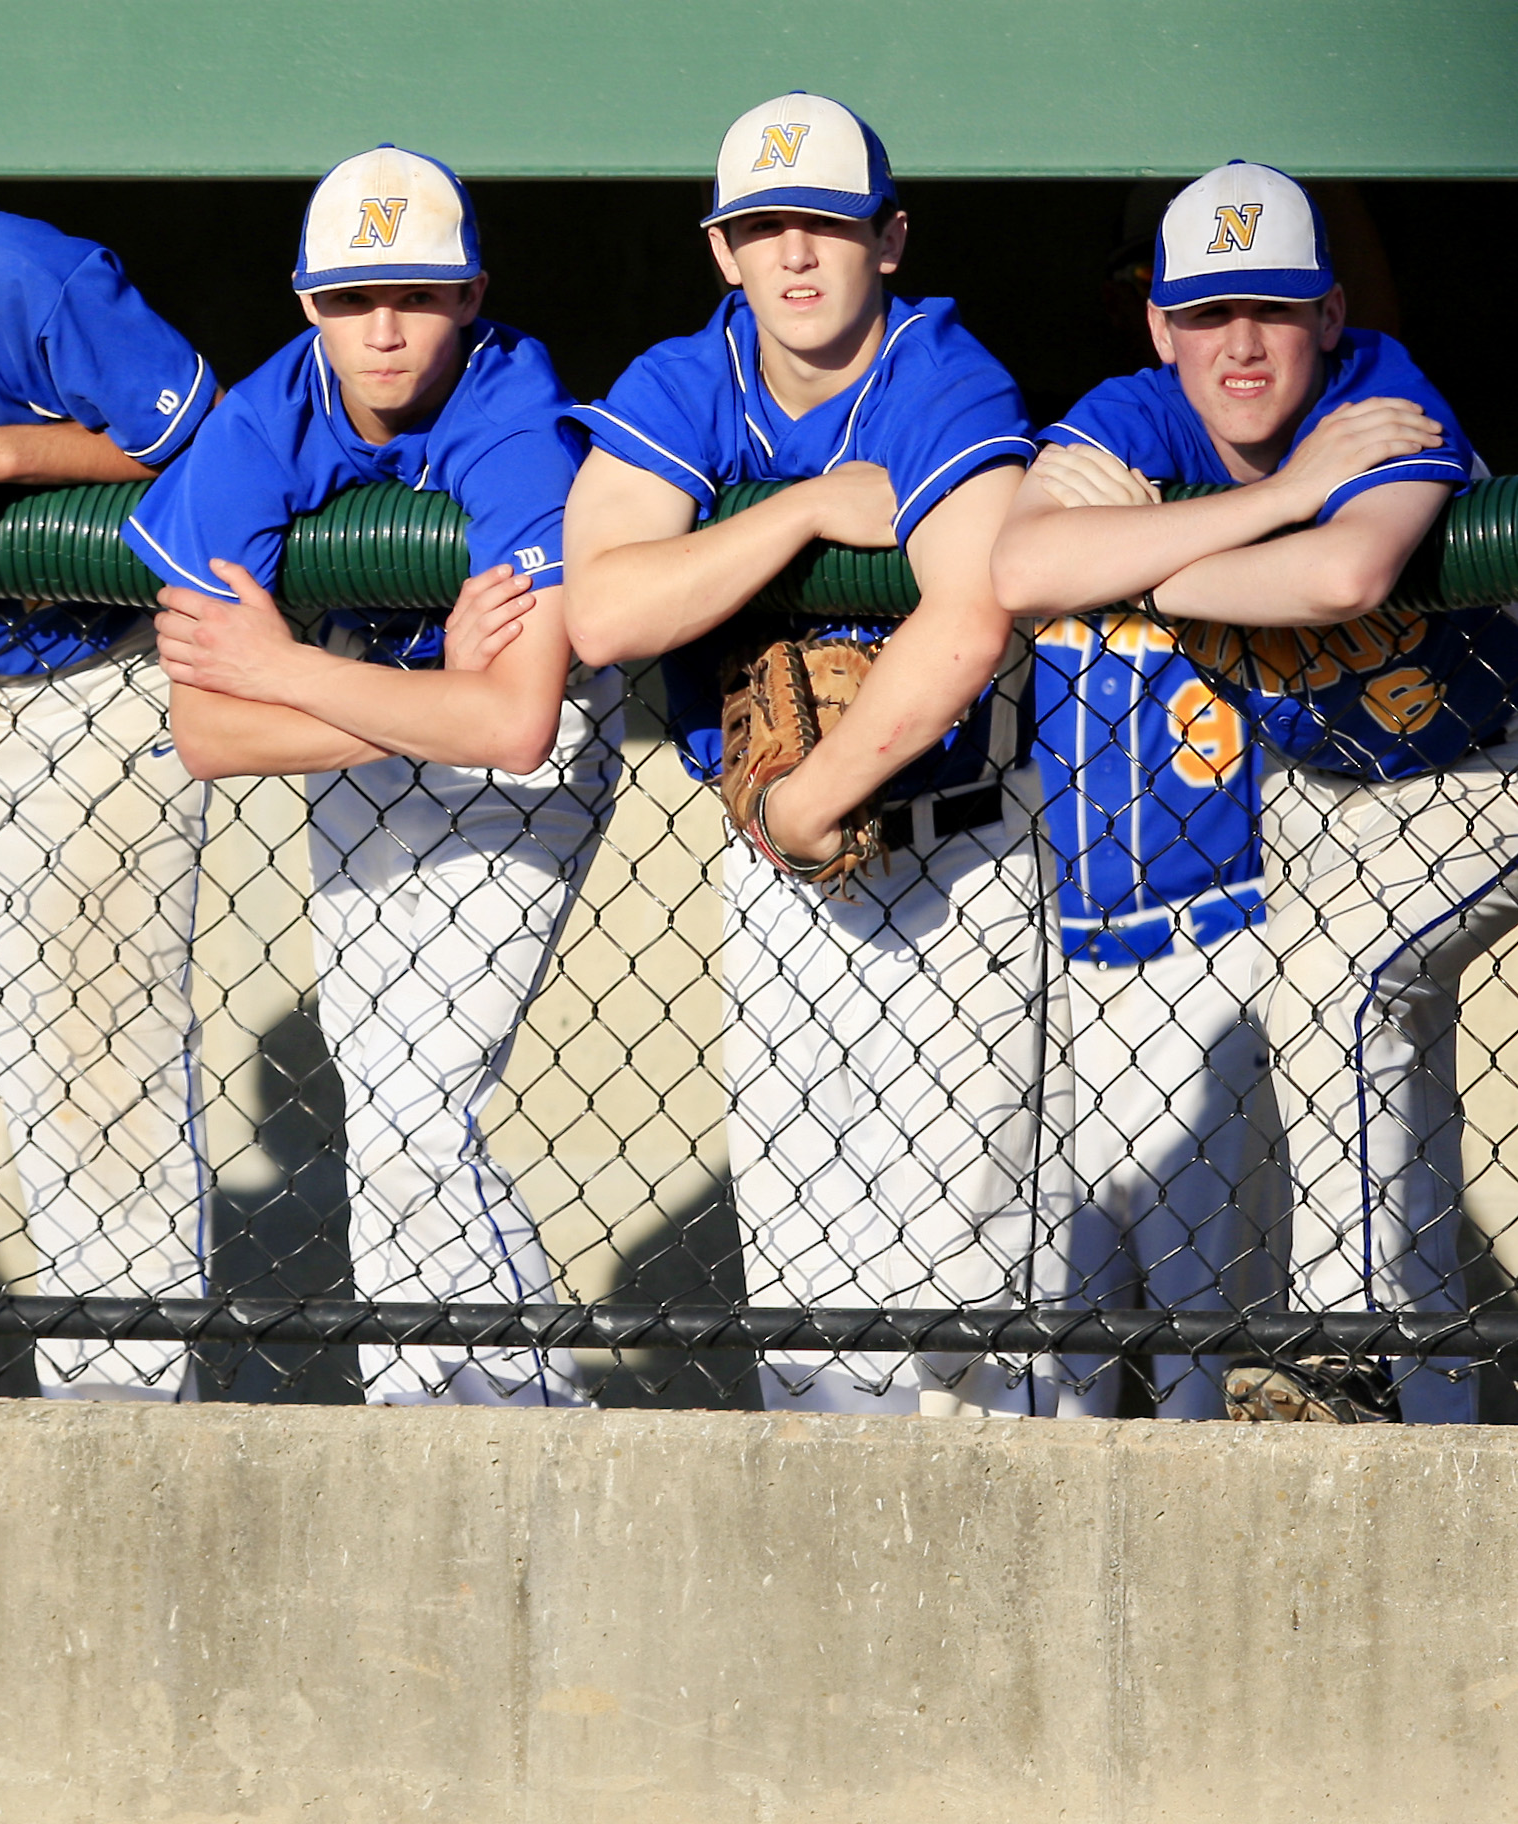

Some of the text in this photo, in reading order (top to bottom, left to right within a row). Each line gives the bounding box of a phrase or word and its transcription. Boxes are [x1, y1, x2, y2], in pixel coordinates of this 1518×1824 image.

[751, 123, 810, 173] N
[349, 197, 408, 250] N
[1206, 203, 1264, 255] N
[1360, 665, 1448, 735] 6
[1167, 677, 1245, 789] 9
